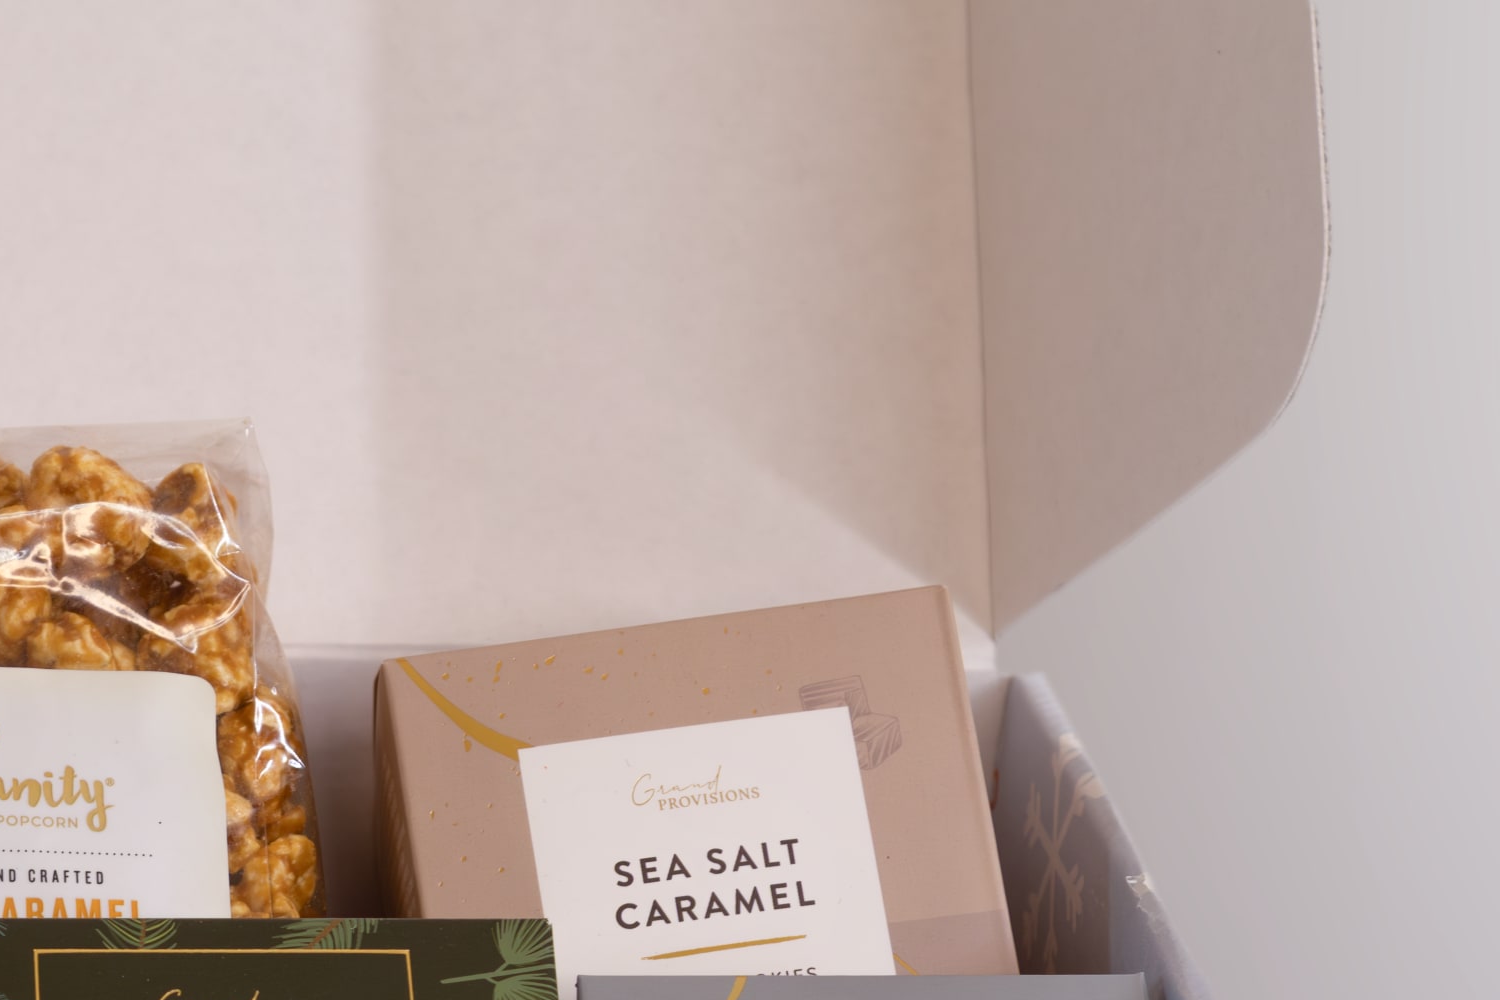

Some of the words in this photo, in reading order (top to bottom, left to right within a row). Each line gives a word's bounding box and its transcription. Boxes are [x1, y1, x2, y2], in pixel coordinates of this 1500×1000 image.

[631, 765, 722, 806] Grand
[657, 786, 761, 811] PROVISIONS
[27, 868, 105, 886] CRAFTED
[613, 853, 692, 888] SEA
[706, 838, 800, 875] SALT
[615, 880, 816, 930] CARAMEL
